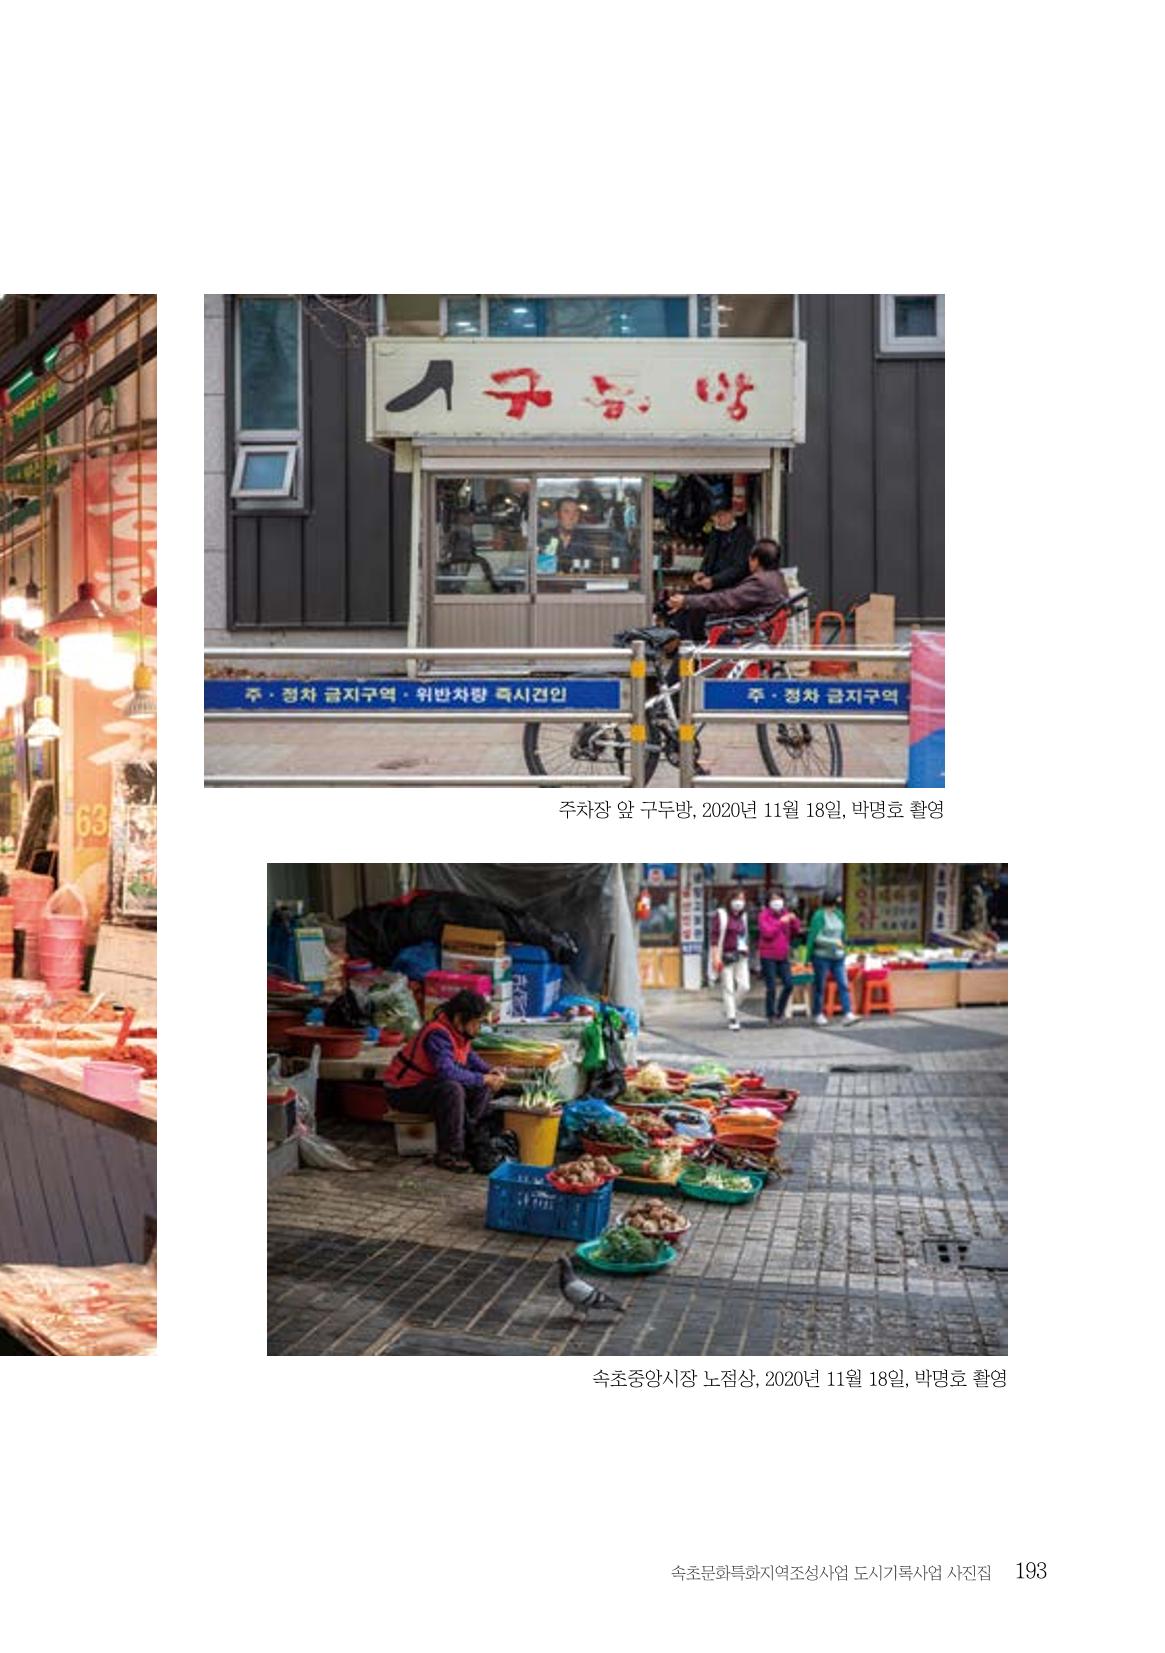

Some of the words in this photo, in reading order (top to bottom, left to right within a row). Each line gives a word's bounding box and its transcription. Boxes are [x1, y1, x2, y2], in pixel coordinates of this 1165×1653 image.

[244, 687, 263, 703] 주
[281, 687, 318, 703] 정차
[324, 687, 397, 703] 금지구역
[415, 687, 489, 703] 위반차량
[494, 687, 568, 703] 즉시견인
[747, 687, 766, 704] 주
[784, 688, 821, 704] 정차
[826, 688, 899, 705] 금지구역
[76, 804, 108, 837] 63
